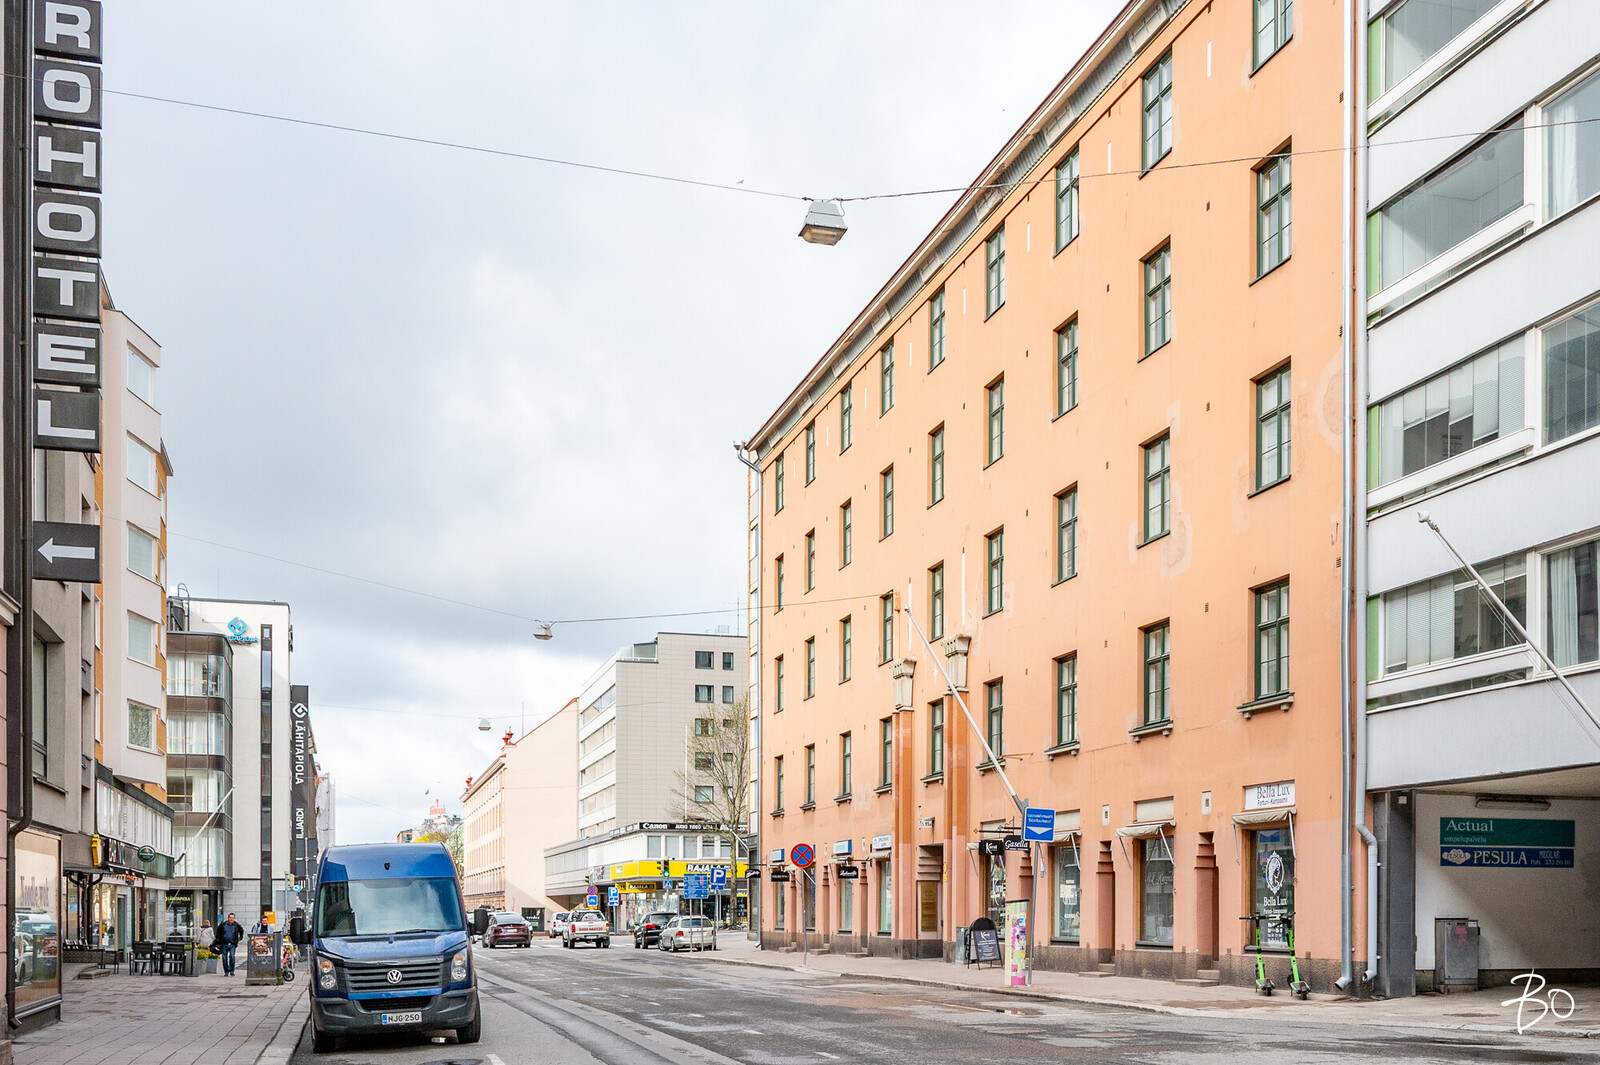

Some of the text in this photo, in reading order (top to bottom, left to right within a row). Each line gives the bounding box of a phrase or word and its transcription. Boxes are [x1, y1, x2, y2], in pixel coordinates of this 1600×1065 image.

[295, 720, 306, 785] LÄHITAPIOLA
[1257, 784, 1290, 799] Bella Lux
[1446, 820, 1494, 832] Actual
[1473, 850, 1528, 865] PESULA
[713, 870, 724, 883] P
[387, 1013, 420, 1022] NJG-250
